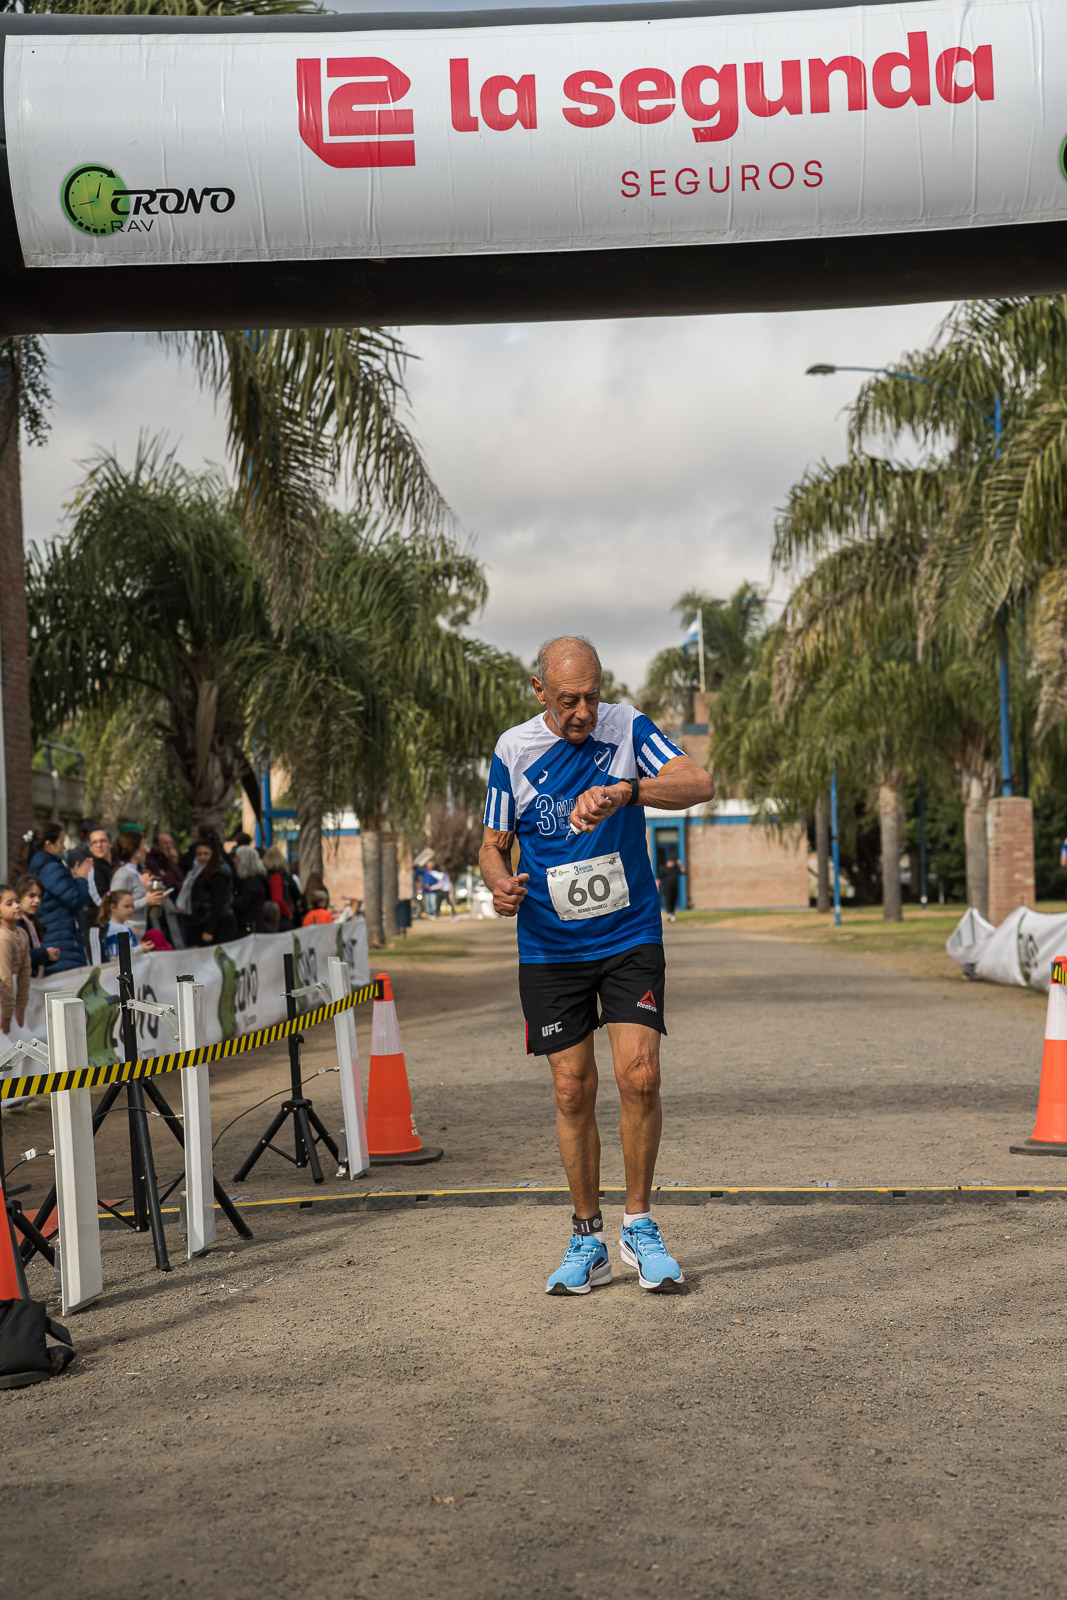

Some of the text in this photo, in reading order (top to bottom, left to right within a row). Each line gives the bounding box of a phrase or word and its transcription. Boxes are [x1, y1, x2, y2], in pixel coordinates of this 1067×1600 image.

[449, 31, 995, 143] la segunda
[620, 160, 824, 199] SEGUROS
[110, 187, 235, 215] CRONO
[110, 219, 154, 233] RAV
[535, 793, 557, 836] 3
[567, 874, 611, 907] 60
[636, 1001, 658, 1013] Reebok
[541, 1021, 563, 1037] UFC
